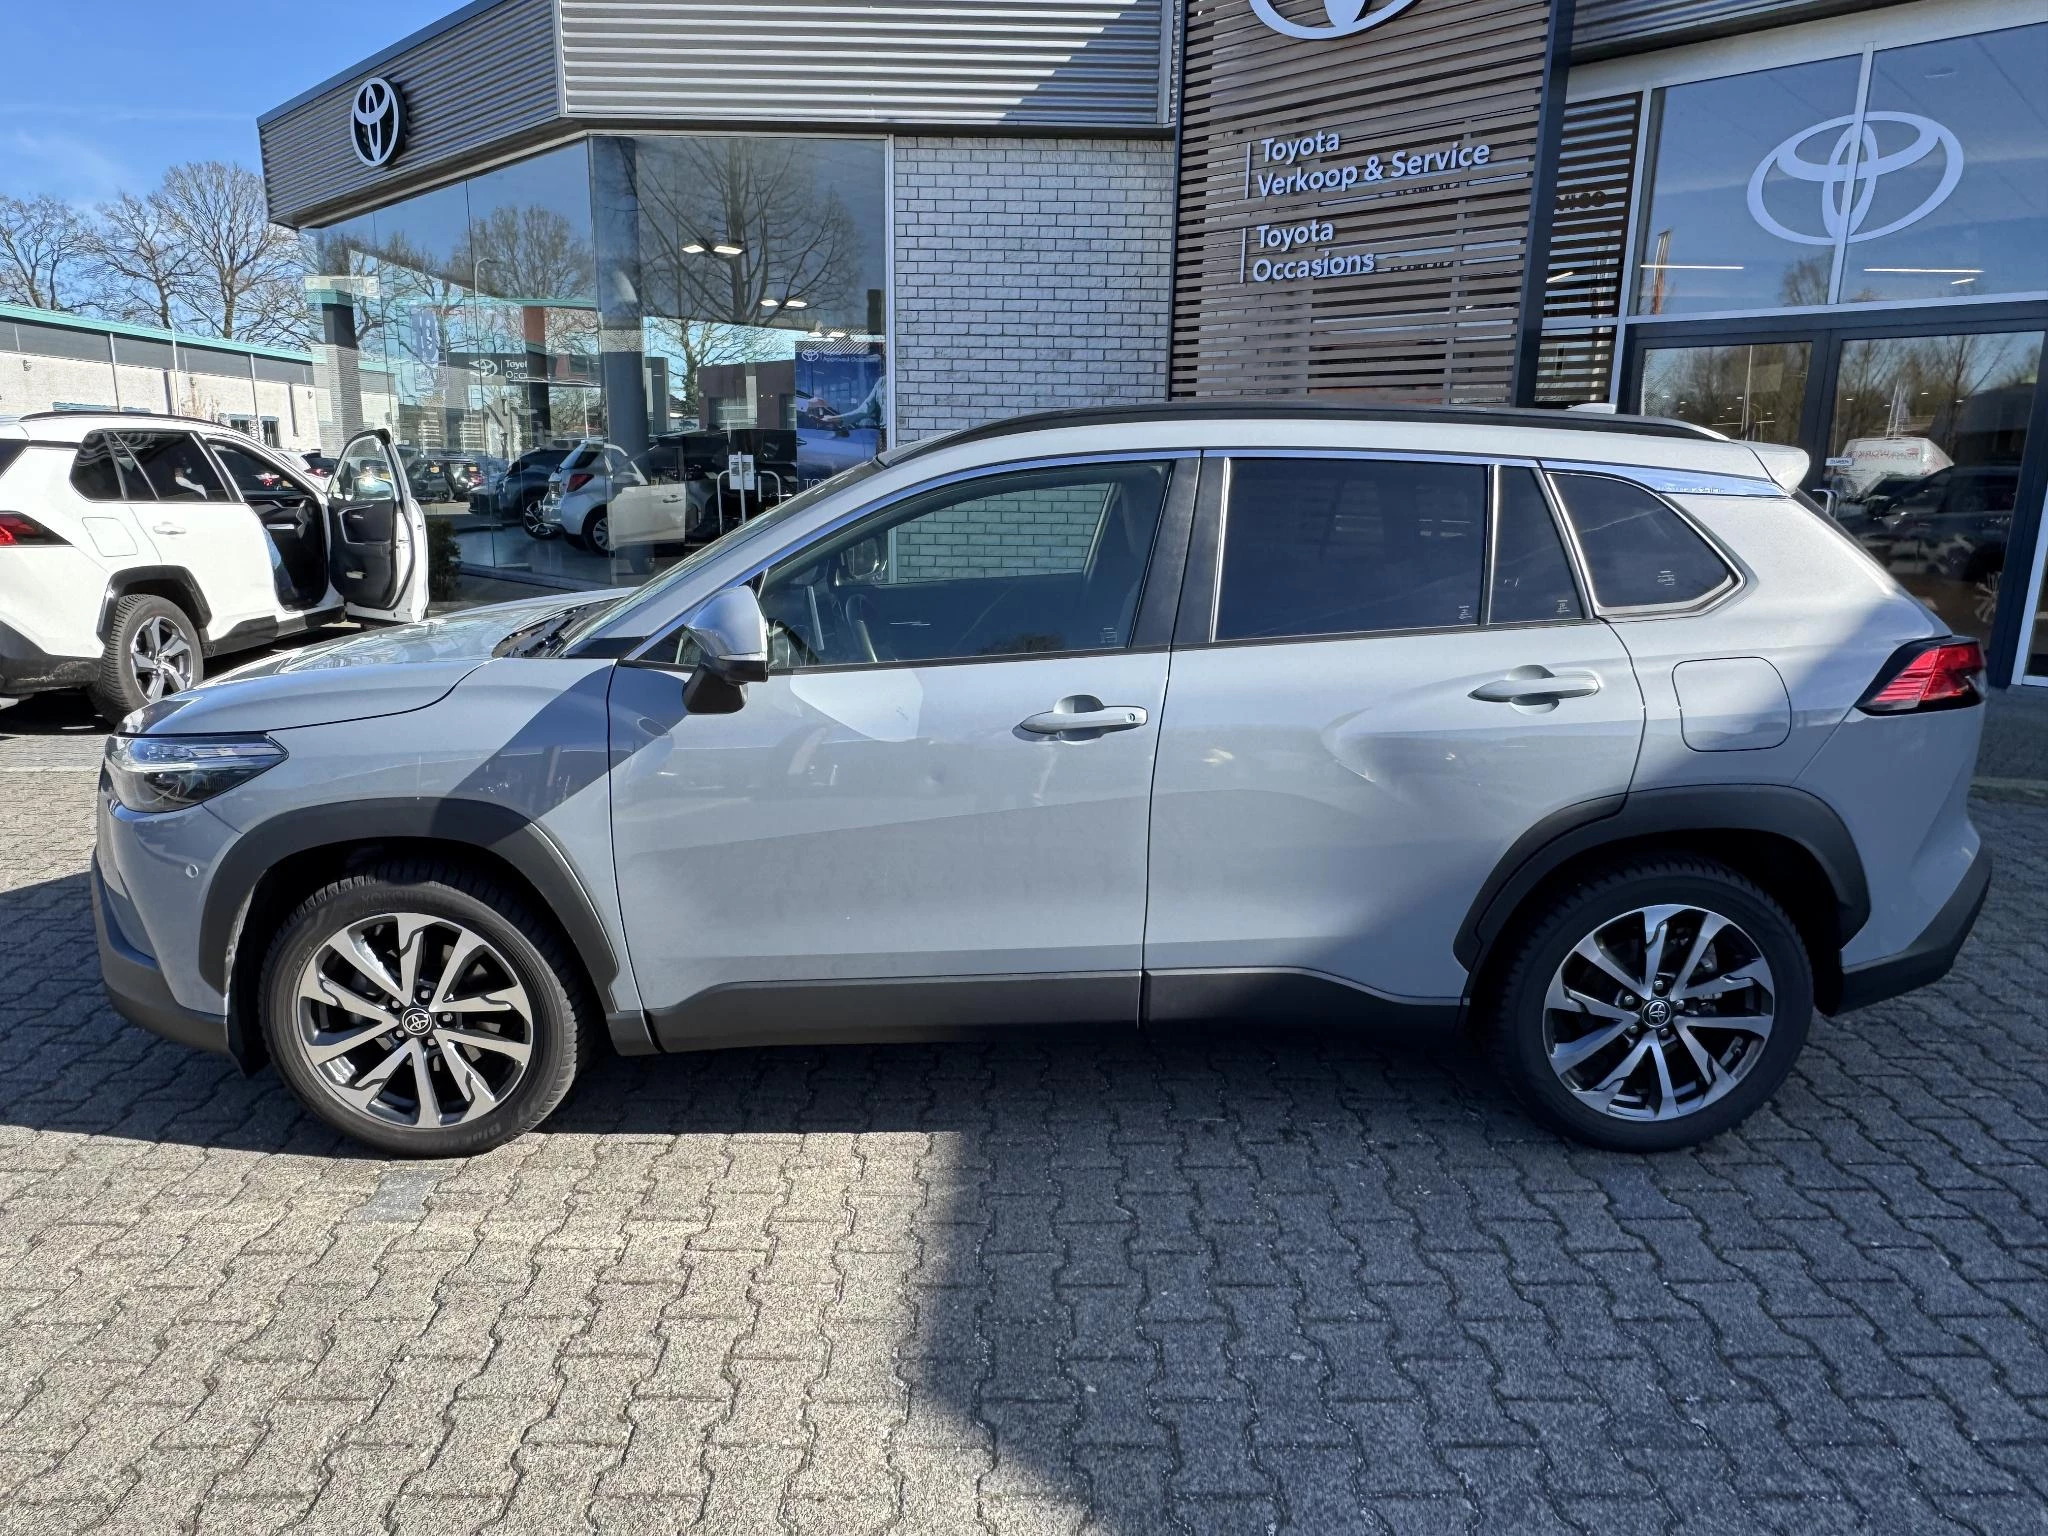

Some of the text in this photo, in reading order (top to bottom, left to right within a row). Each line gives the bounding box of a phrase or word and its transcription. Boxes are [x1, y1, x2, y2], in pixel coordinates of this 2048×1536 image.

[1260, 130, 1340, 165] Toyota
[1257, 141, 1490, 197] Verkoop & Service
[1256, 219, 1334, 252] Toyota
[1252, 250, 1375, 282] Occasions
